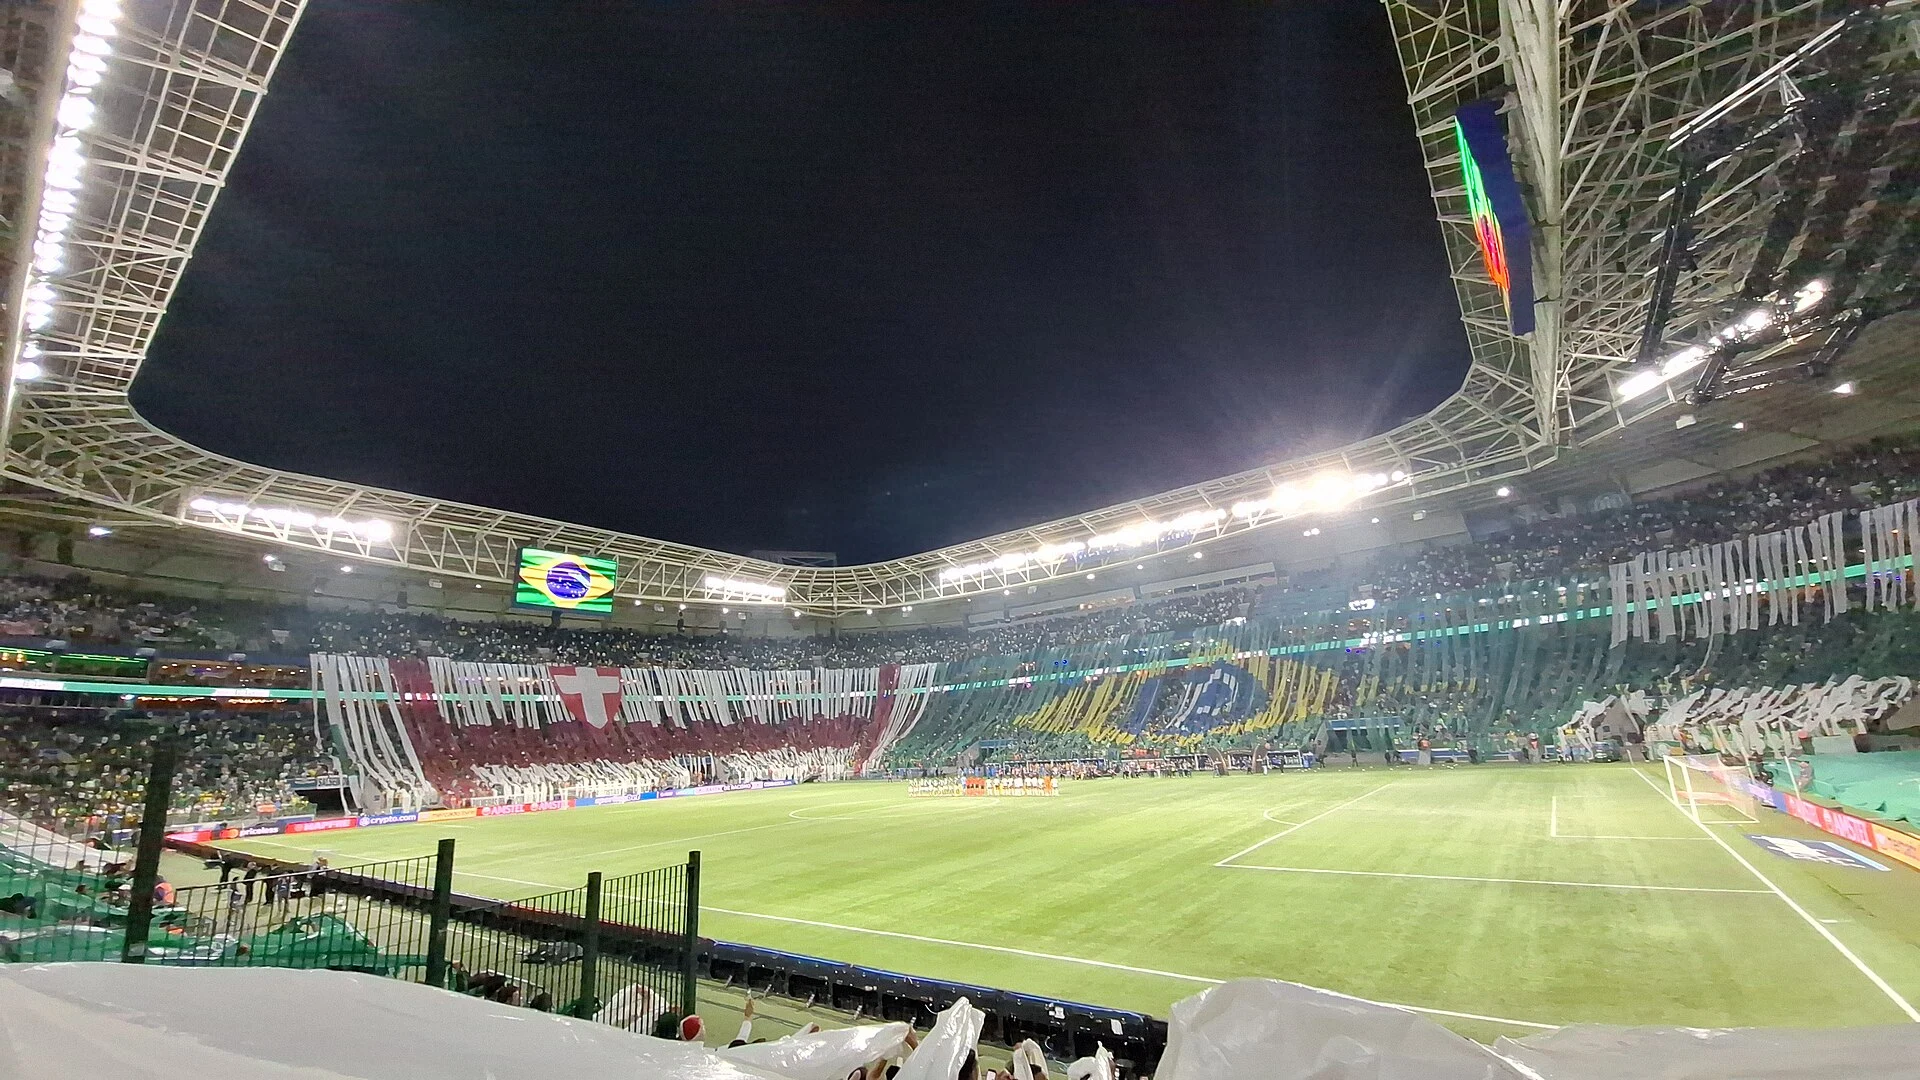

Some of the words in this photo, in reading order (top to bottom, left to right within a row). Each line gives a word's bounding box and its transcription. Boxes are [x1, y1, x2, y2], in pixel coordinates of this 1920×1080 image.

[491, 804, 525, 815] AMSTEL
[371, 814, 416, 824] crypto.com
[239, 826, 279, 837] priceless
